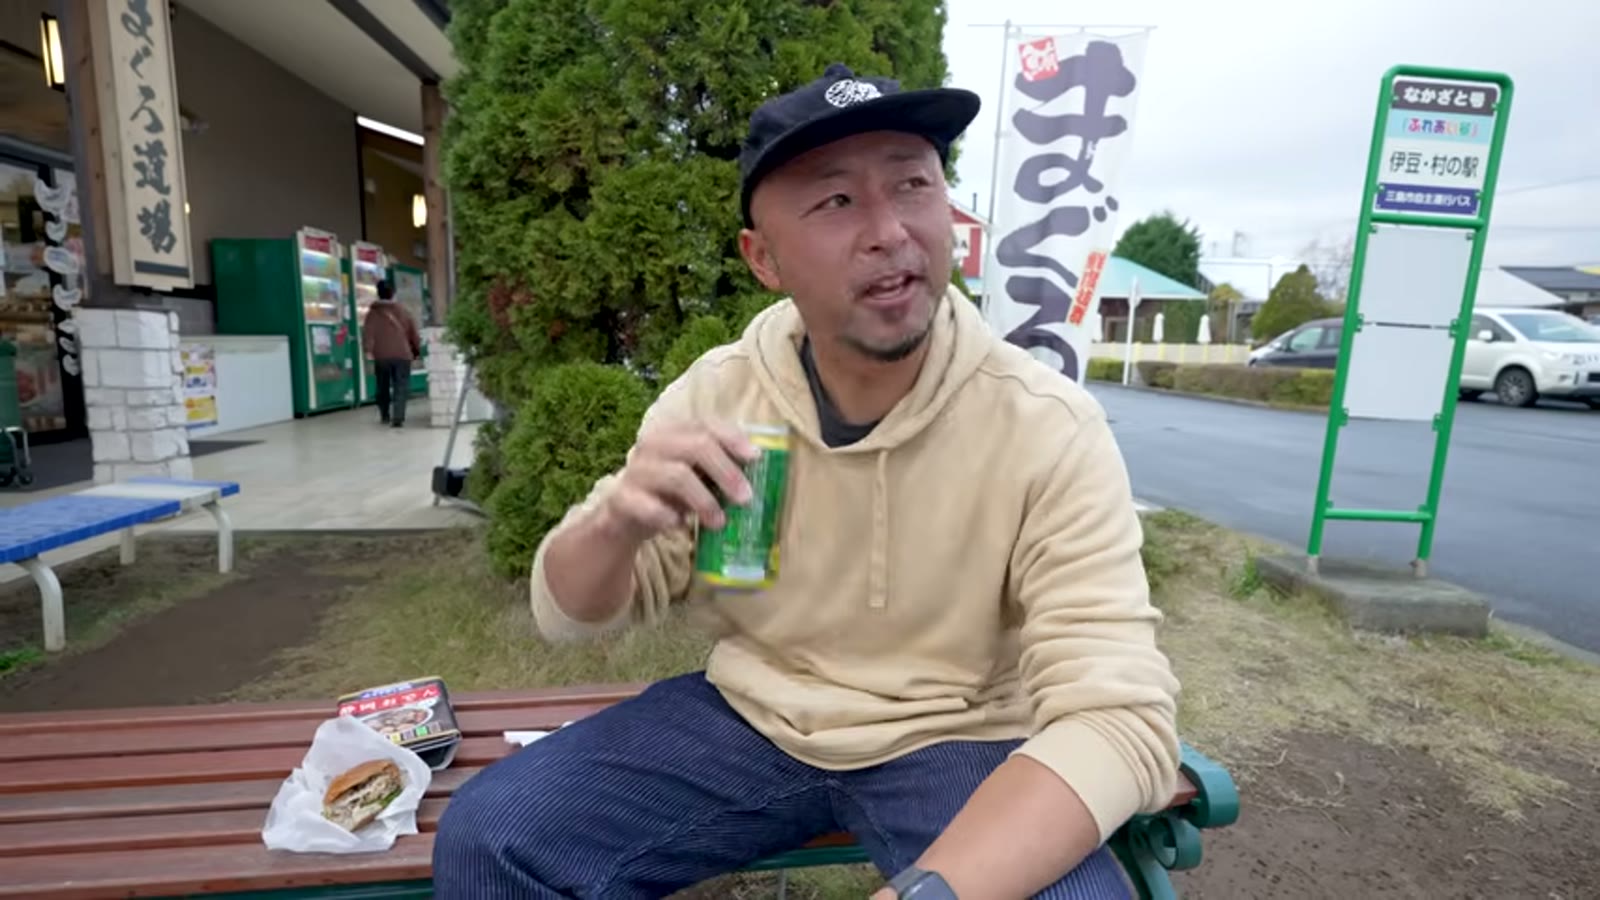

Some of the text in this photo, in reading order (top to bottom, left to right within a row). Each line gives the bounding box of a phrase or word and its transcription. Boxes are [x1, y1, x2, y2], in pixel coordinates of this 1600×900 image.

[1402, 86, 1486, 109] なかざと号
[1389, 151, 1479, 178] 伊豆・村の駅
